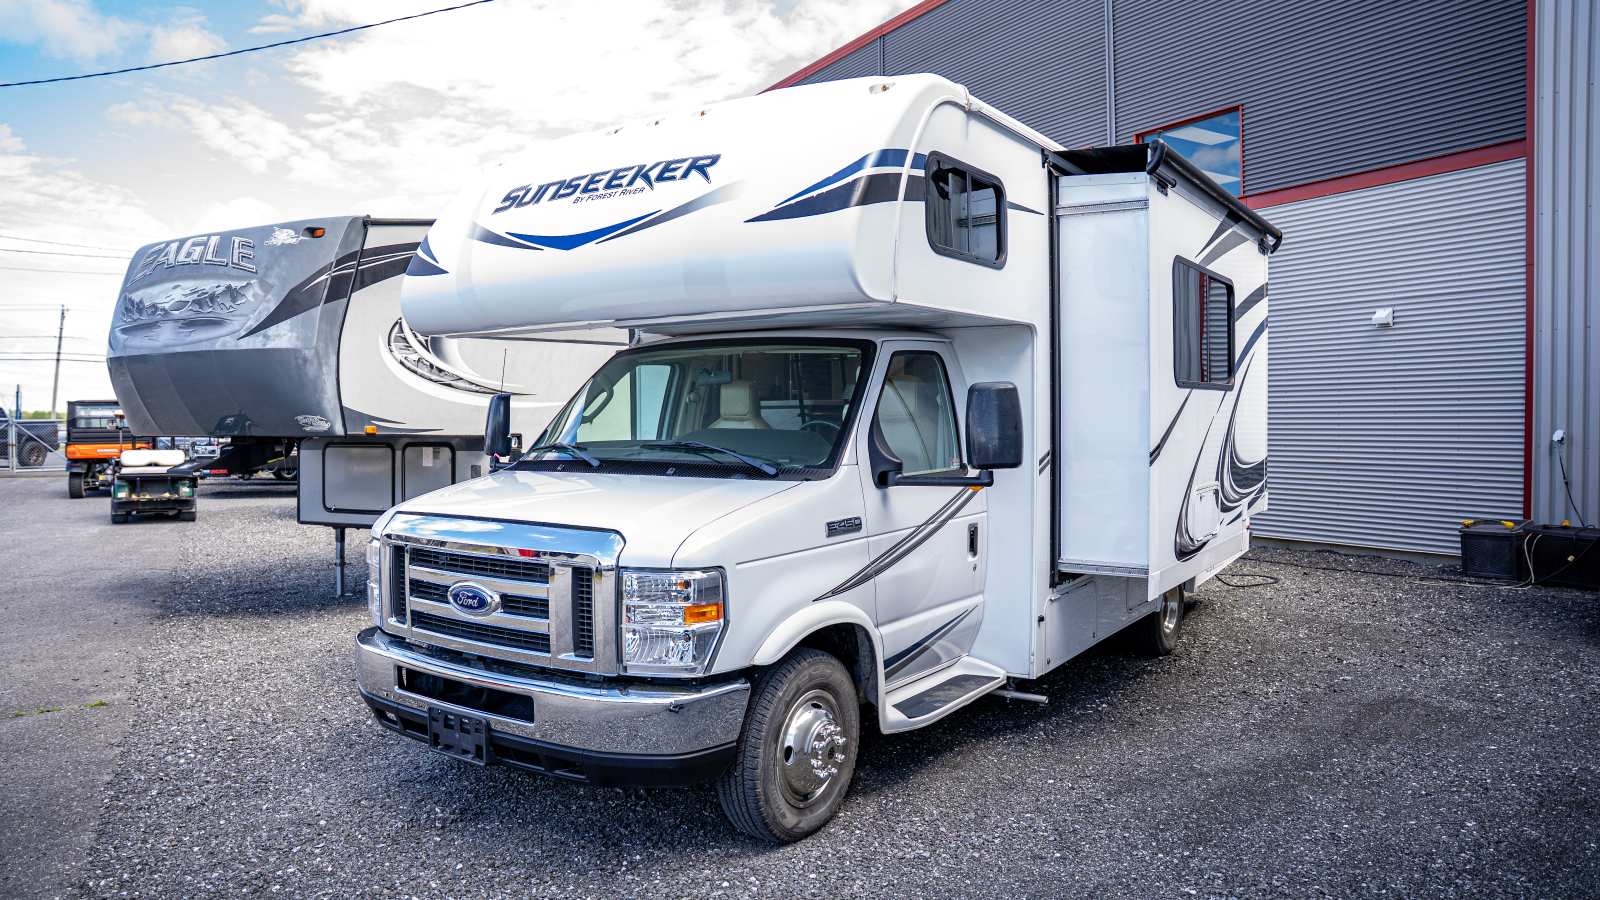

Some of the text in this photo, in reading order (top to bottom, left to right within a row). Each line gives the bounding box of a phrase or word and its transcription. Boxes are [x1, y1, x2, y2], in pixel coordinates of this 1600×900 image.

[491, 153, 722, 215] SUNSEEKER
[573, 186, 646, 204] BY FOREST RIVER
[127, 236, 258, 288] EAGLE
[457, 590, 480, 608] Ford
